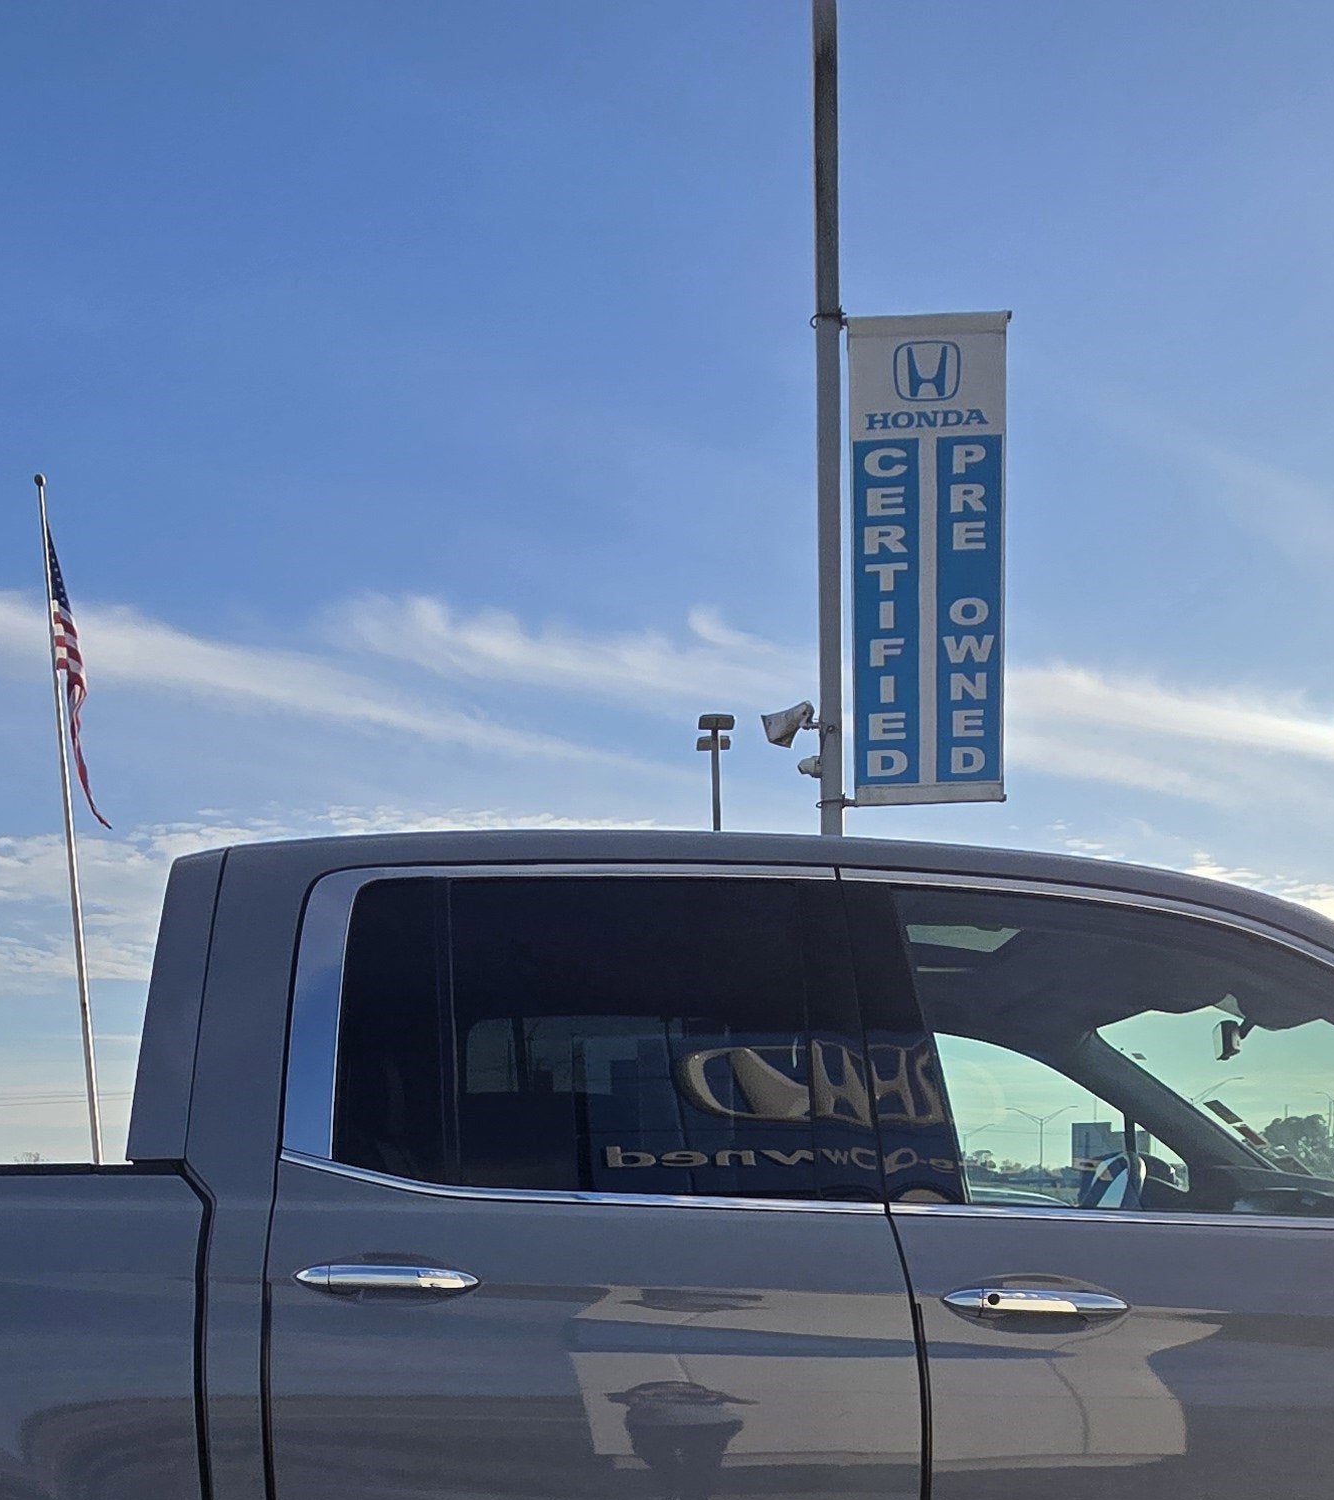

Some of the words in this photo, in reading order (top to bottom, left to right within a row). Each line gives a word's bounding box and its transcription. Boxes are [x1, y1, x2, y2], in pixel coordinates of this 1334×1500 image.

[865, 408, 988, 431] HONDA
[950, 444, 987, 551] PRE
[863, 446, 908, 779] CERTIFIED
[942, 596, 995, 775] OWNED
